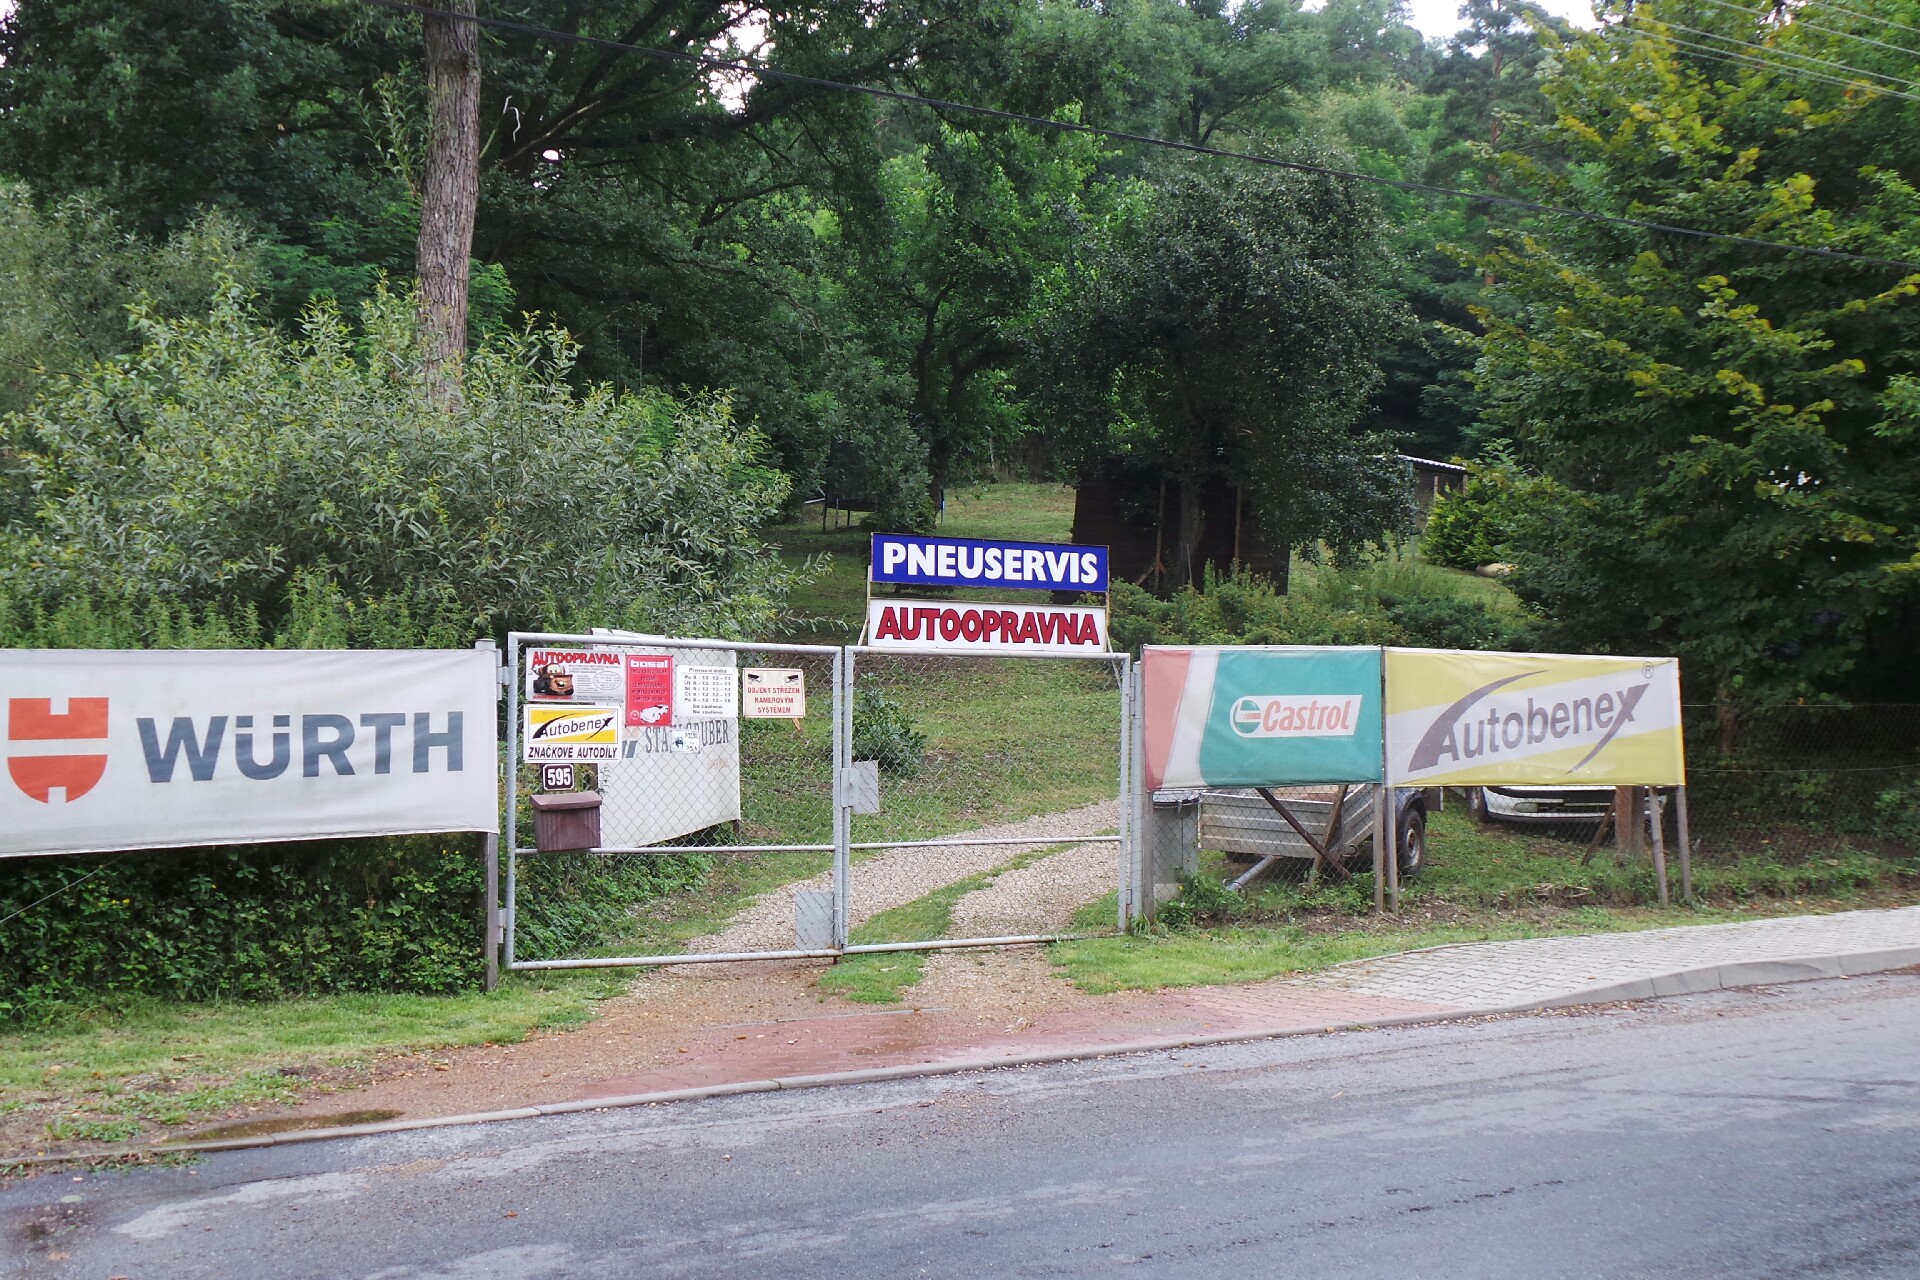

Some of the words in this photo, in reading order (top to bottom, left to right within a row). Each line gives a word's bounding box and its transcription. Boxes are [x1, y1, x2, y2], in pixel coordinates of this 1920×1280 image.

[883, 542, 1098, 584] PNEUSERVIS
[875, 606, 1100, 646] AUTOOPRAVNA
[532, 651, 621, 667] AUTOOPRAVNA
[630, 660, 668, 668] bosal
[754, 696, 794, 704] KAMEROVÝM
[772, 686, 800, 694] STŘEŽEN
[758, 705, 791, 714] SYSTÉMEM
[1262, 697, 1352, 732] Castrol
[532, 716, 614, 739] Autobenex
[645, 720, 729, 753] STAUBER
[1408, 684, 1650, 773] Autobenex
[136, 711, 464, 783] WÜRTH
[528, 745, 574, 758] ZNAČKOVÉ
[576, 745, 618, 758] AUTODÍLY
[548, 768, 571, 786] 595
